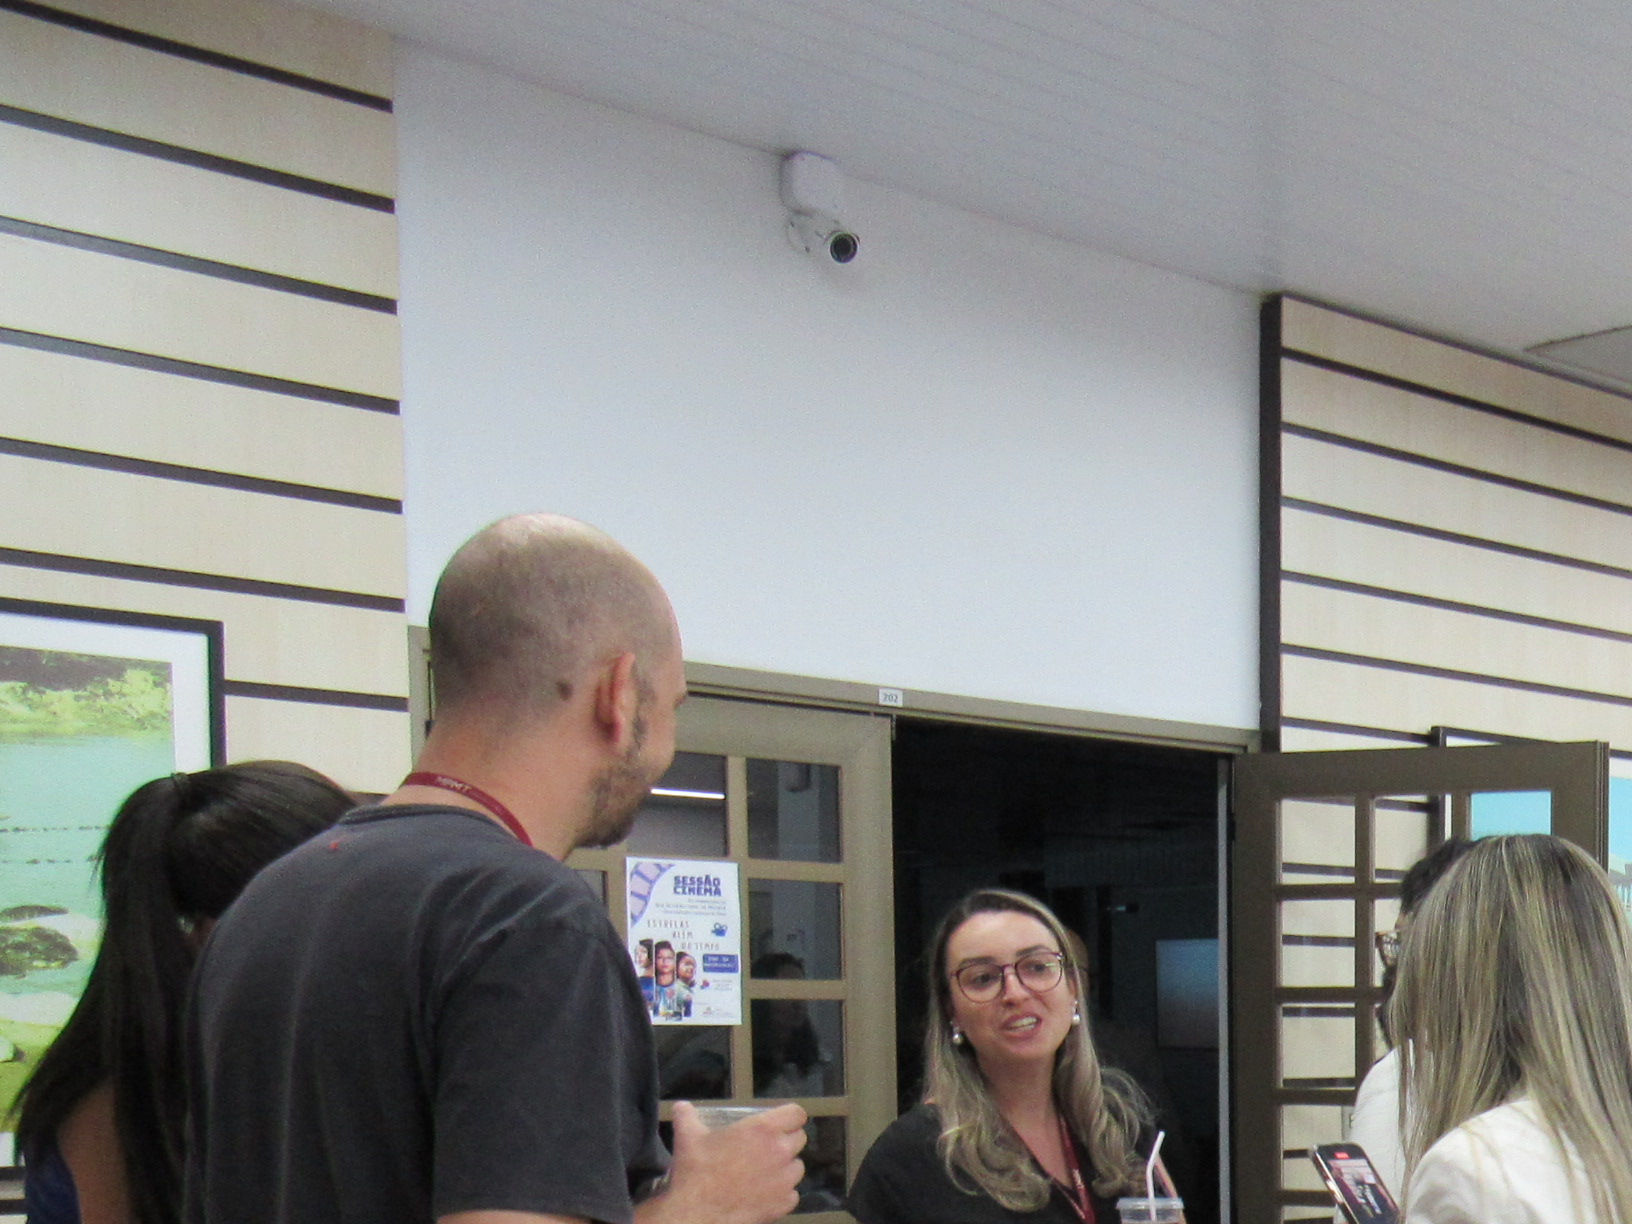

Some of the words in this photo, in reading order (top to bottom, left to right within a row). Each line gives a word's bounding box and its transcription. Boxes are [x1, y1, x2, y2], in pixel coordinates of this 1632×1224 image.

[883, 693, 898, 703] 202
[674, 874, 721, 887] SESSÃO
[673, 885, 722, 897] CINEMA
[647, 919, 689, 929] ESTRELAS
